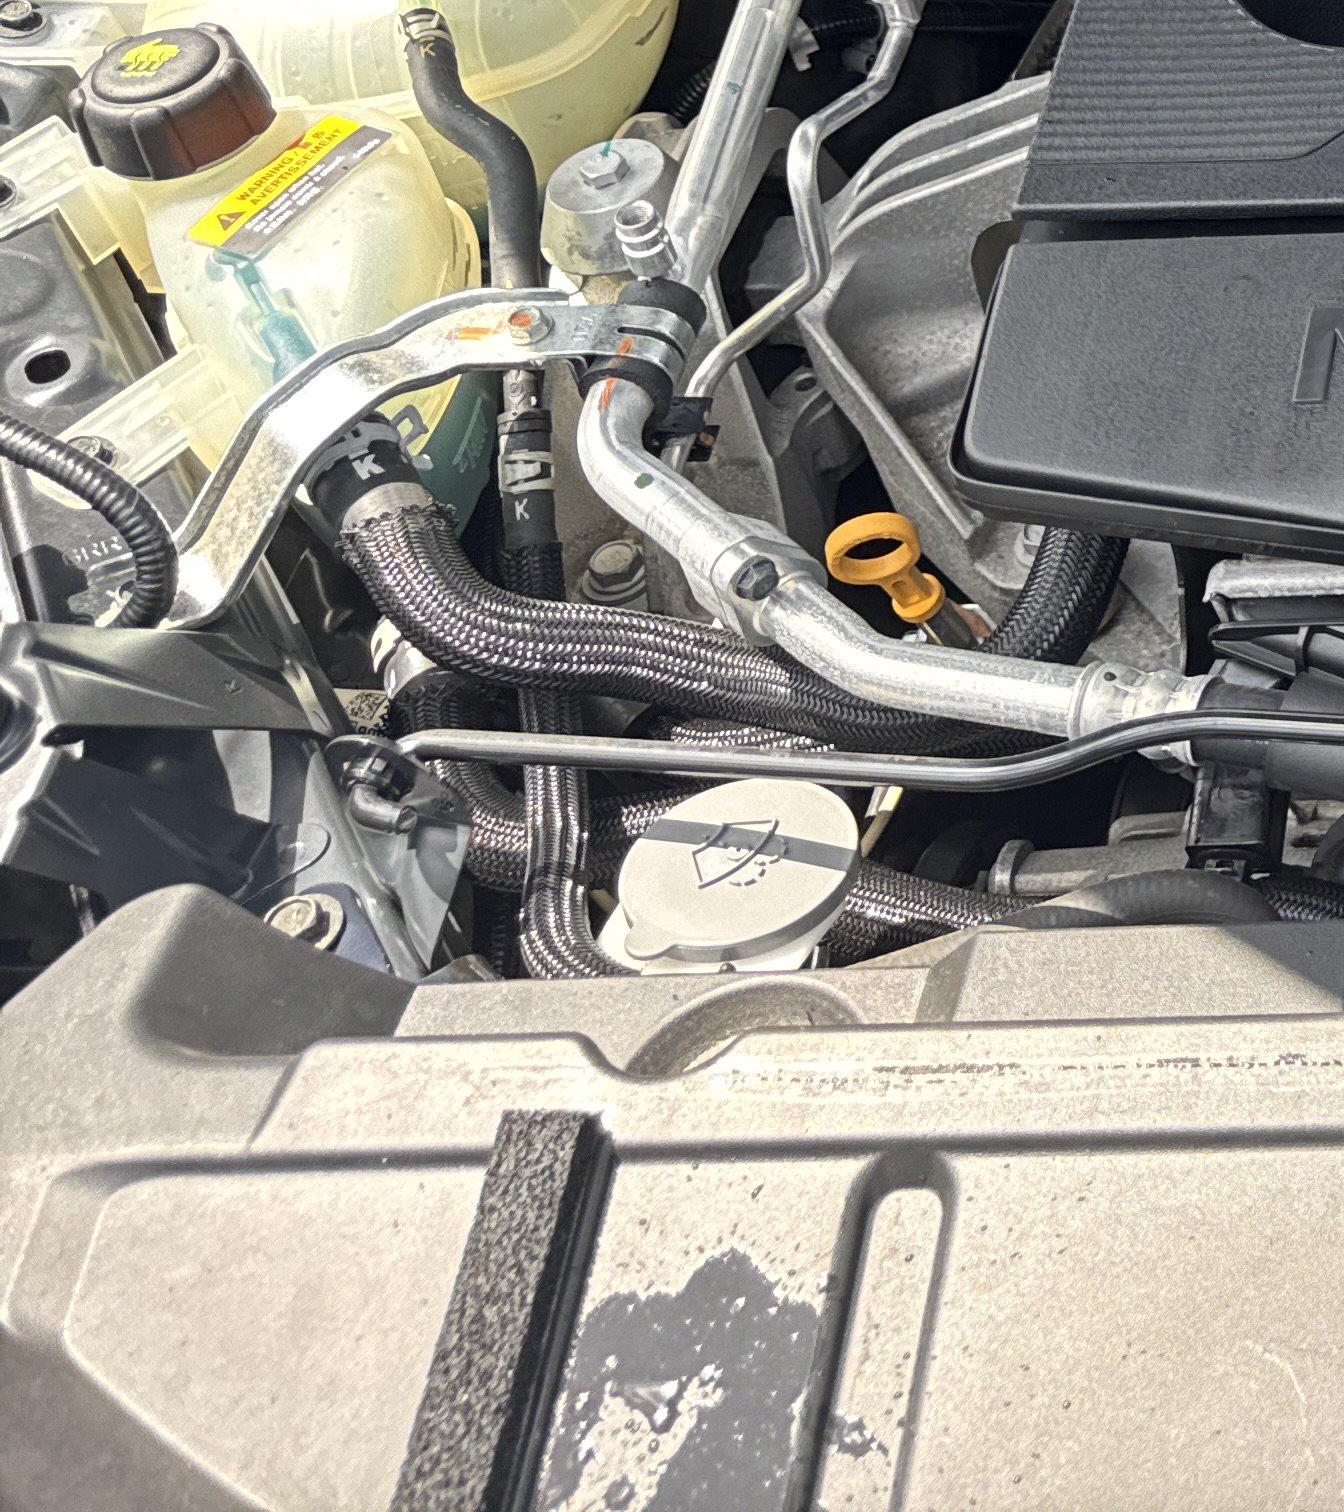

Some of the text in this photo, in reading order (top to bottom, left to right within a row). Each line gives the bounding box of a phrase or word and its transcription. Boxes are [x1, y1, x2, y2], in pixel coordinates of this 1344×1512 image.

[236, 155, 293, 202] WARNING
[249, 128, 343, 205] AVERTISSEMENT
[352, 453, 386, 480] K
[515, 498, 530, 520] K
